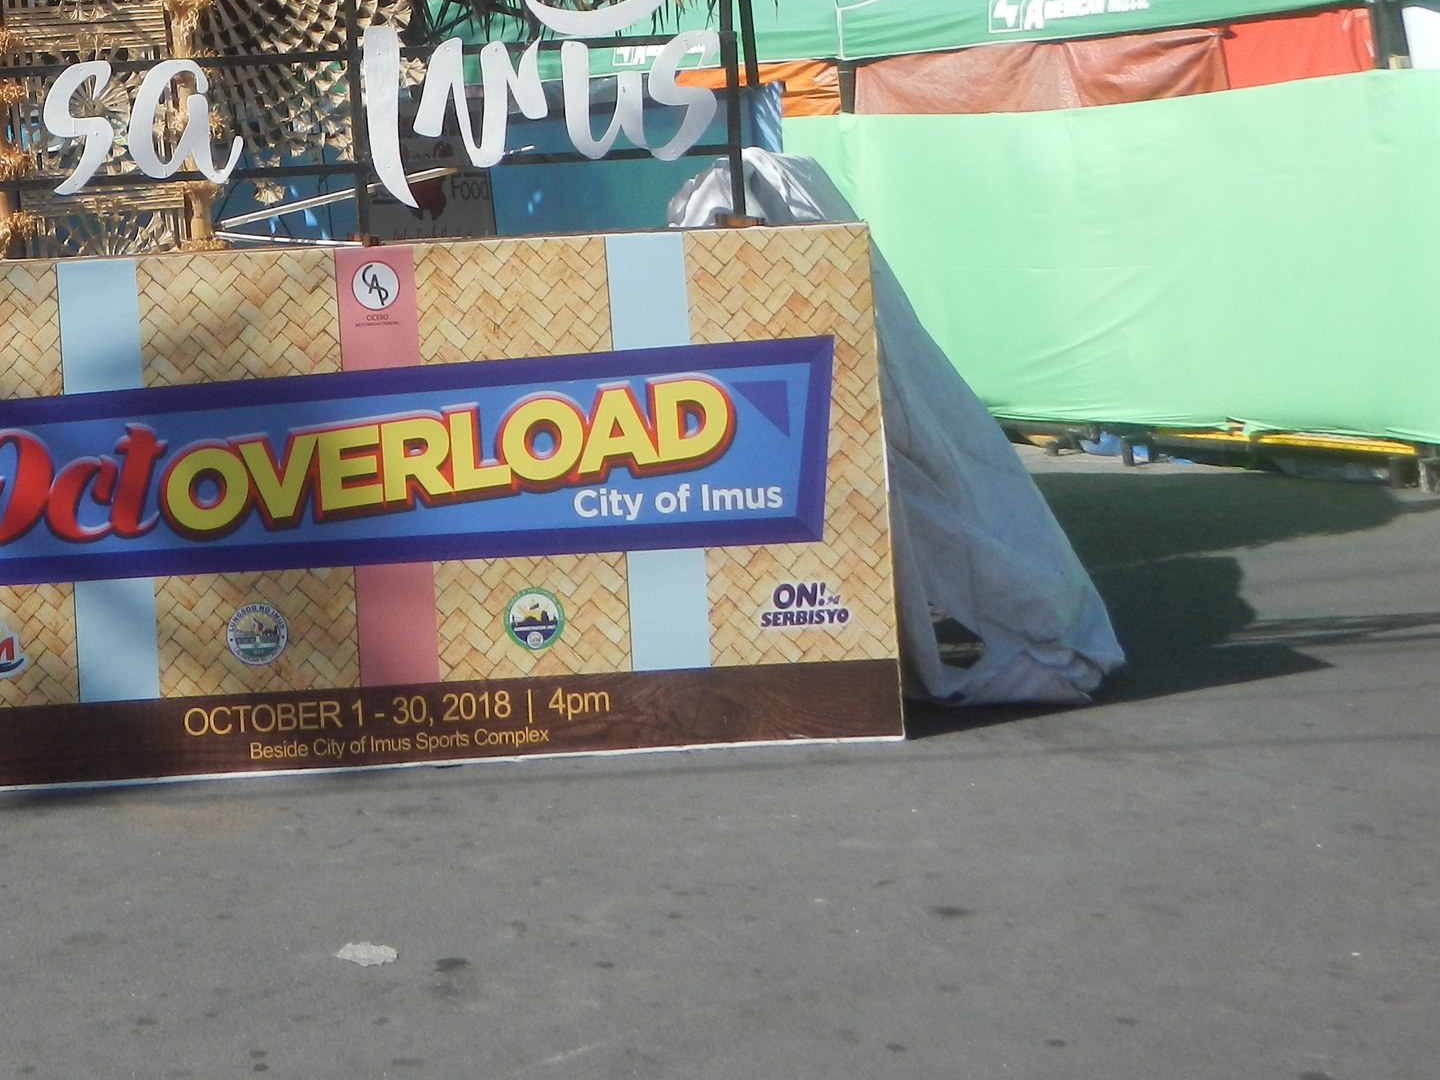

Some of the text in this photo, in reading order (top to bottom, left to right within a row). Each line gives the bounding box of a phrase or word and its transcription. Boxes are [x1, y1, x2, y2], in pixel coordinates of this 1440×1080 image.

[43, 24, 720, 209] sa Imus
[573, 483, 784, 520] City of Imus
[772, 582, 826, 610] ON!
[229, 605, 286, 632] LUNGSOD NG IMUS
[760, 608, 849, 627] SERBISYO
[184, 700, 343, 736] OCTOBER
[351, 699, 364, 727] 1
[392, 695, 434, 727] 30,
[442, 690, 511, 722] 2018
[548, 687, 611, 720] 4pm
[250, 726, 550, 760] Beside City of Imus Sports Complex
